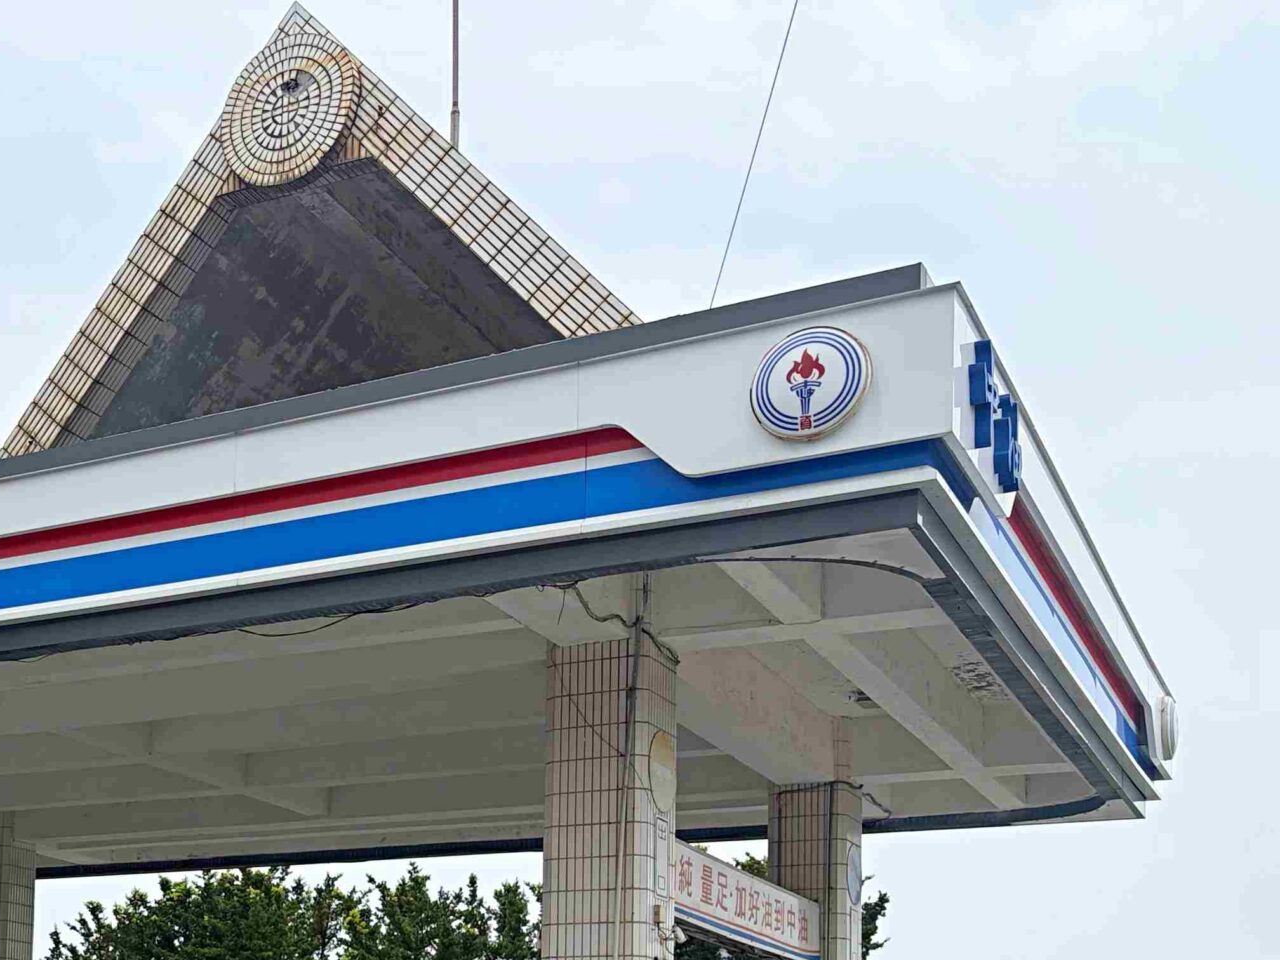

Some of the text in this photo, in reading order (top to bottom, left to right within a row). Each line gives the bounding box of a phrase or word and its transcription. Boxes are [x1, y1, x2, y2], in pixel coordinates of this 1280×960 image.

[673, 854, 809, 944] 純量足·加好油到中油
